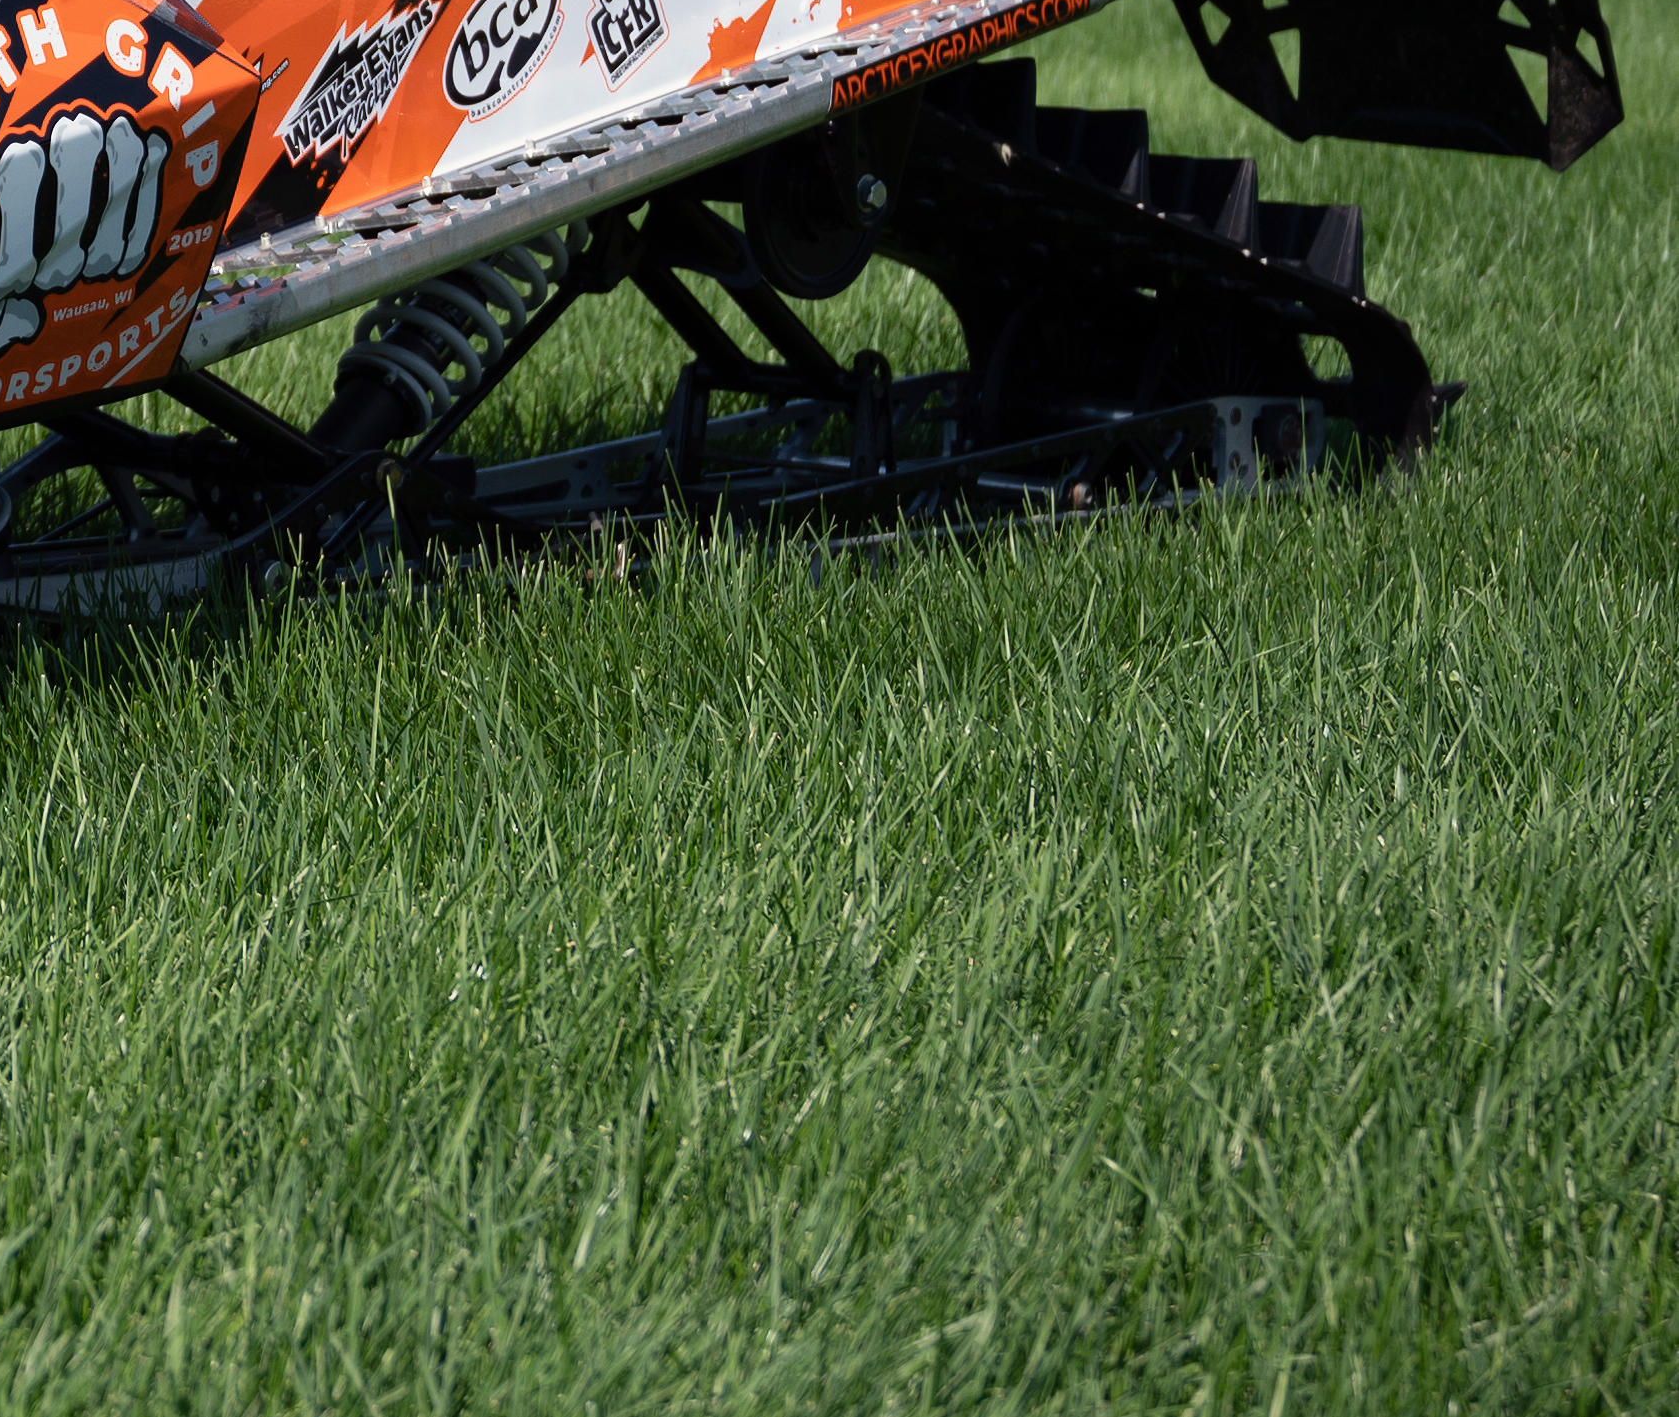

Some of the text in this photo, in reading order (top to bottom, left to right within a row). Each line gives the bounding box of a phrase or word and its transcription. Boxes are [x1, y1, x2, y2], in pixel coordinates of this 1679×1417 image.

[105, 19, 220, 188] GRIP
[284, 68, 372, 160] Walker
[169, 225, 213, 251] 2019
[53, 290, 133, 322] Wausau, WI
